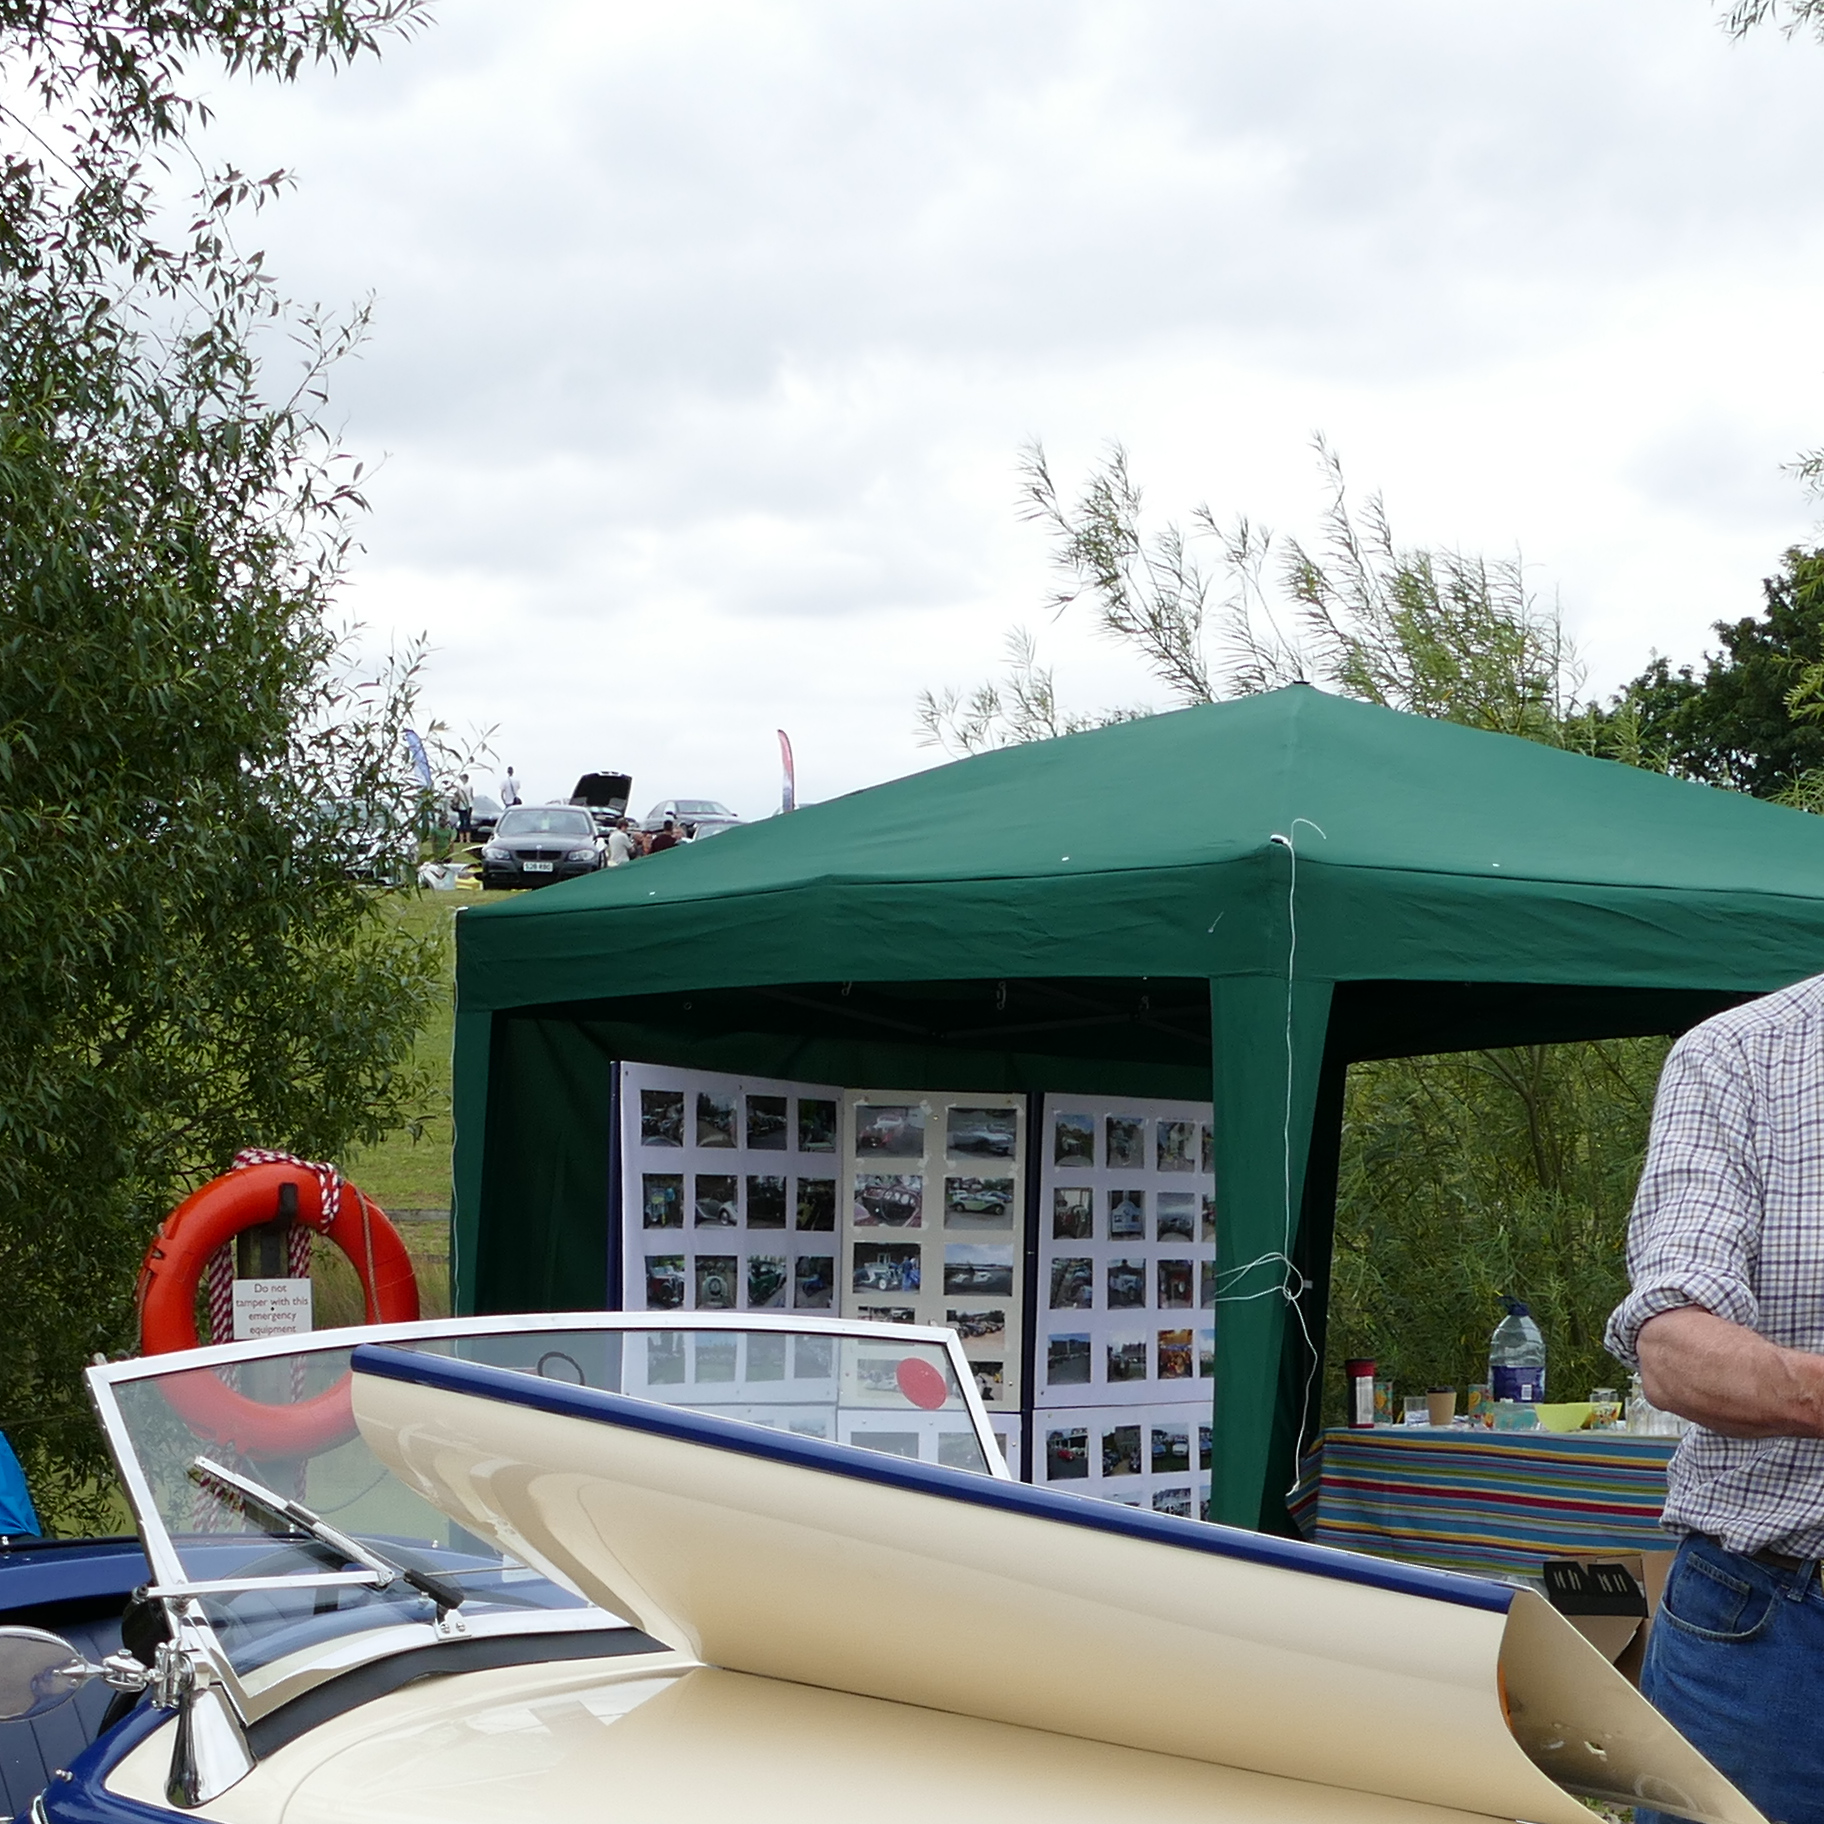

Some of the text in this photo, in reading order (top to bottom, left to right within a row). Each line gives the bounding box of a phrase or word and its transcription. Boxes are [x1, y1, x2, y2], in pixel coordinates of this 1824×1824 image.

[254, 1283, 287, 1293] Do not
[236, 1297, 308, 1309] tamper with this
[249, 1312, 297, 1322] emergency
[249, 1325, 296, 1336] equipment
